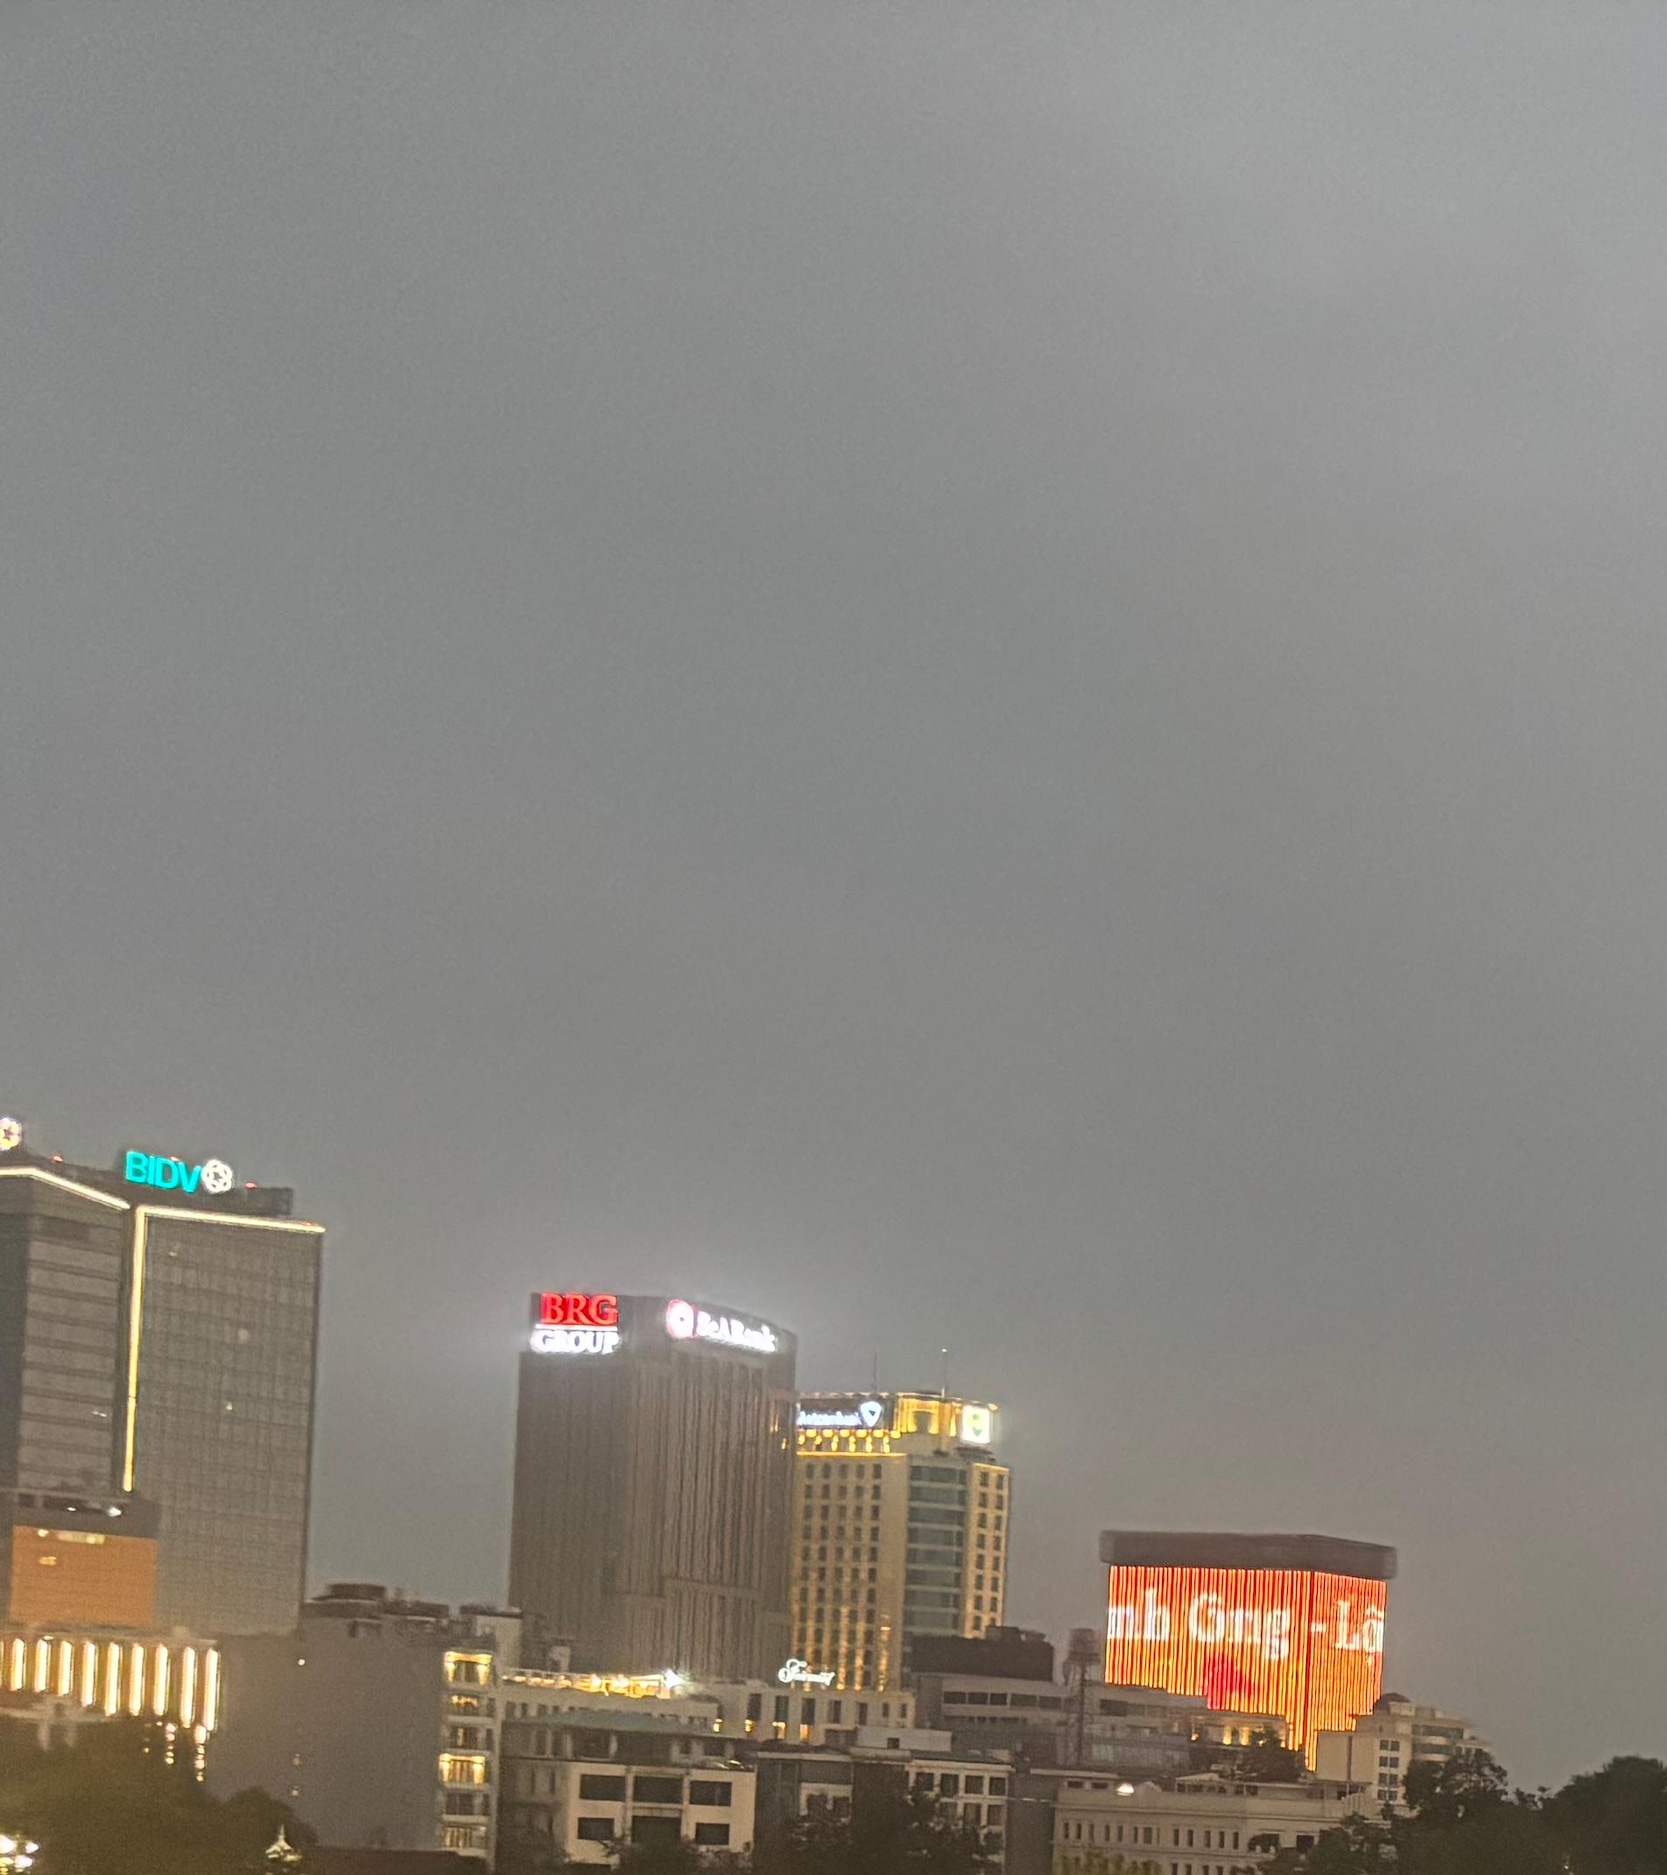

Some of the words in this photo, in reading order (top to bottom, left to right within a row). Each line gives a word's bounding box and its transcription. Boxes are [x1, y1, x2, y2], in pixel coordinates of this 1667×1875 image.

[126, 1151, 201, 1193] BIDV
[541, 1293, 618, 1325] BRG
[531, 1329, 620, 1354] GROUP
